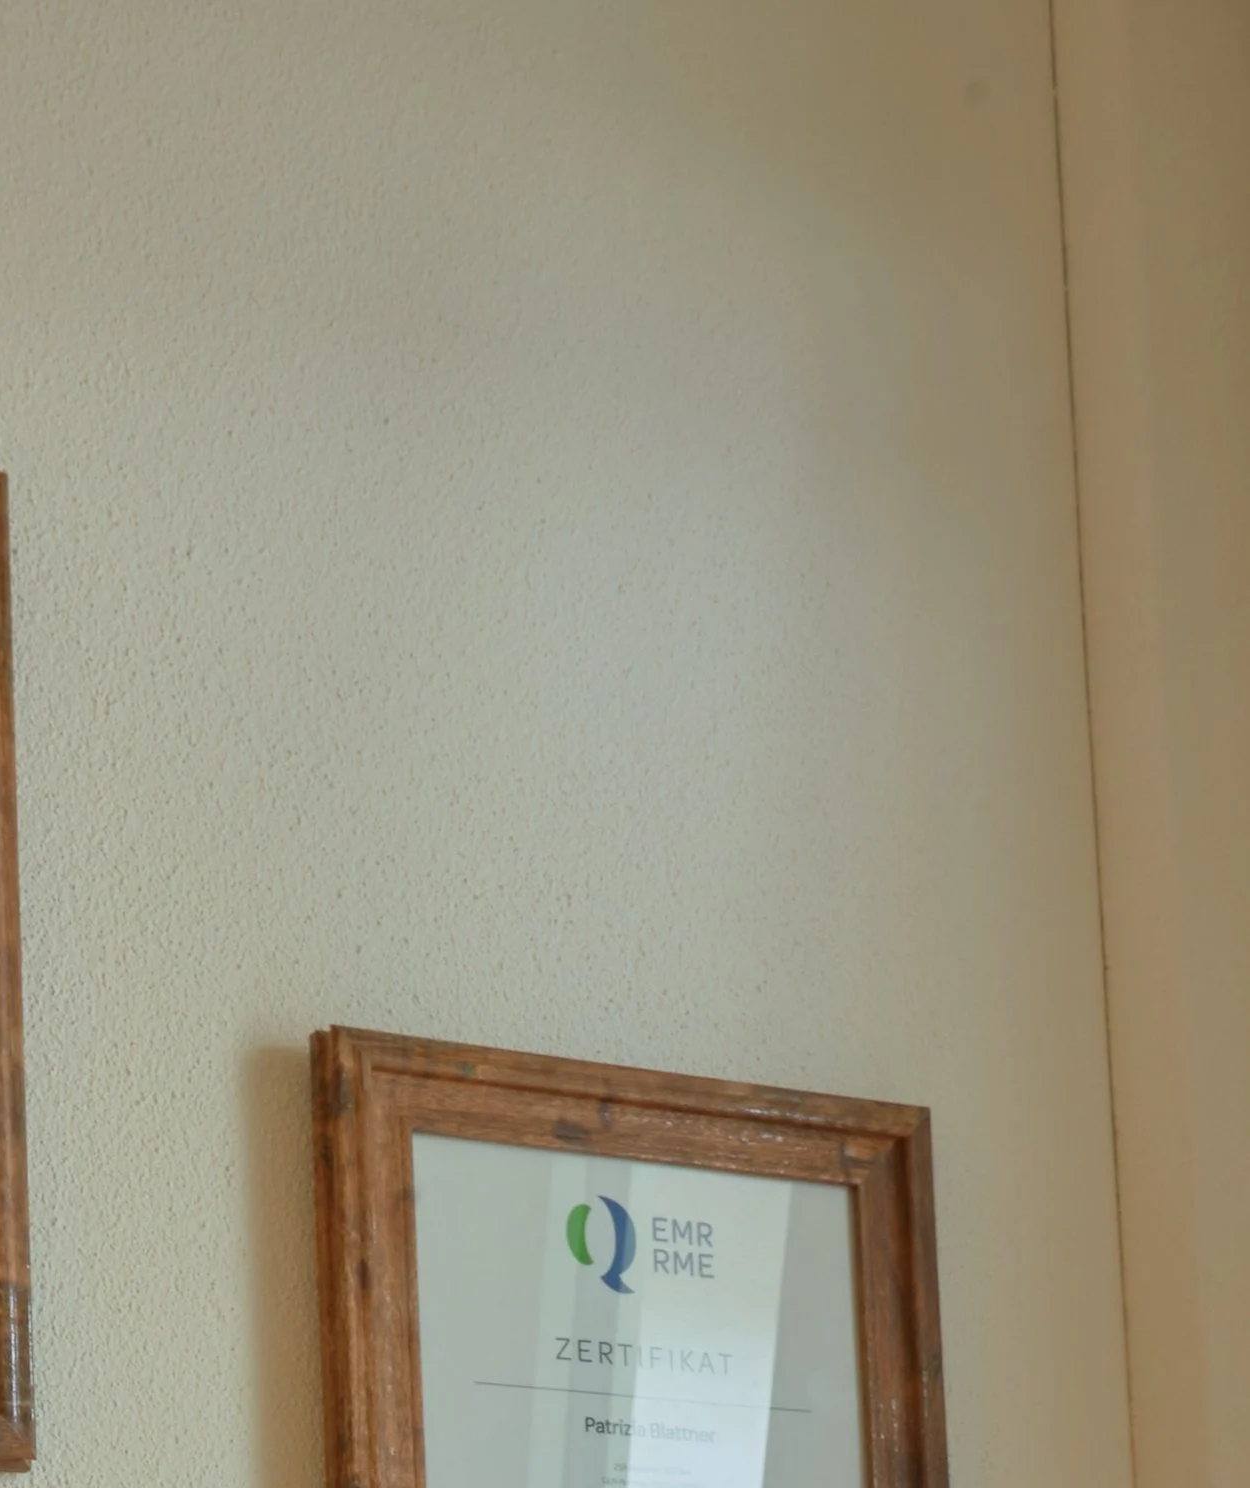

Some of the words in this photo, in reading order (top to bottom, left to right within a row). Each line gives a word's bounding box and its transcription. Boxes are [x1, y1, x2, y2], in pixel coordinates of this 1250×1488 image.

[651, 1216, 713, 1248] EMR
[653, 1248, 715, 1279] RME
[554, 1336, 734, 1376] ZERTIFIKAT
